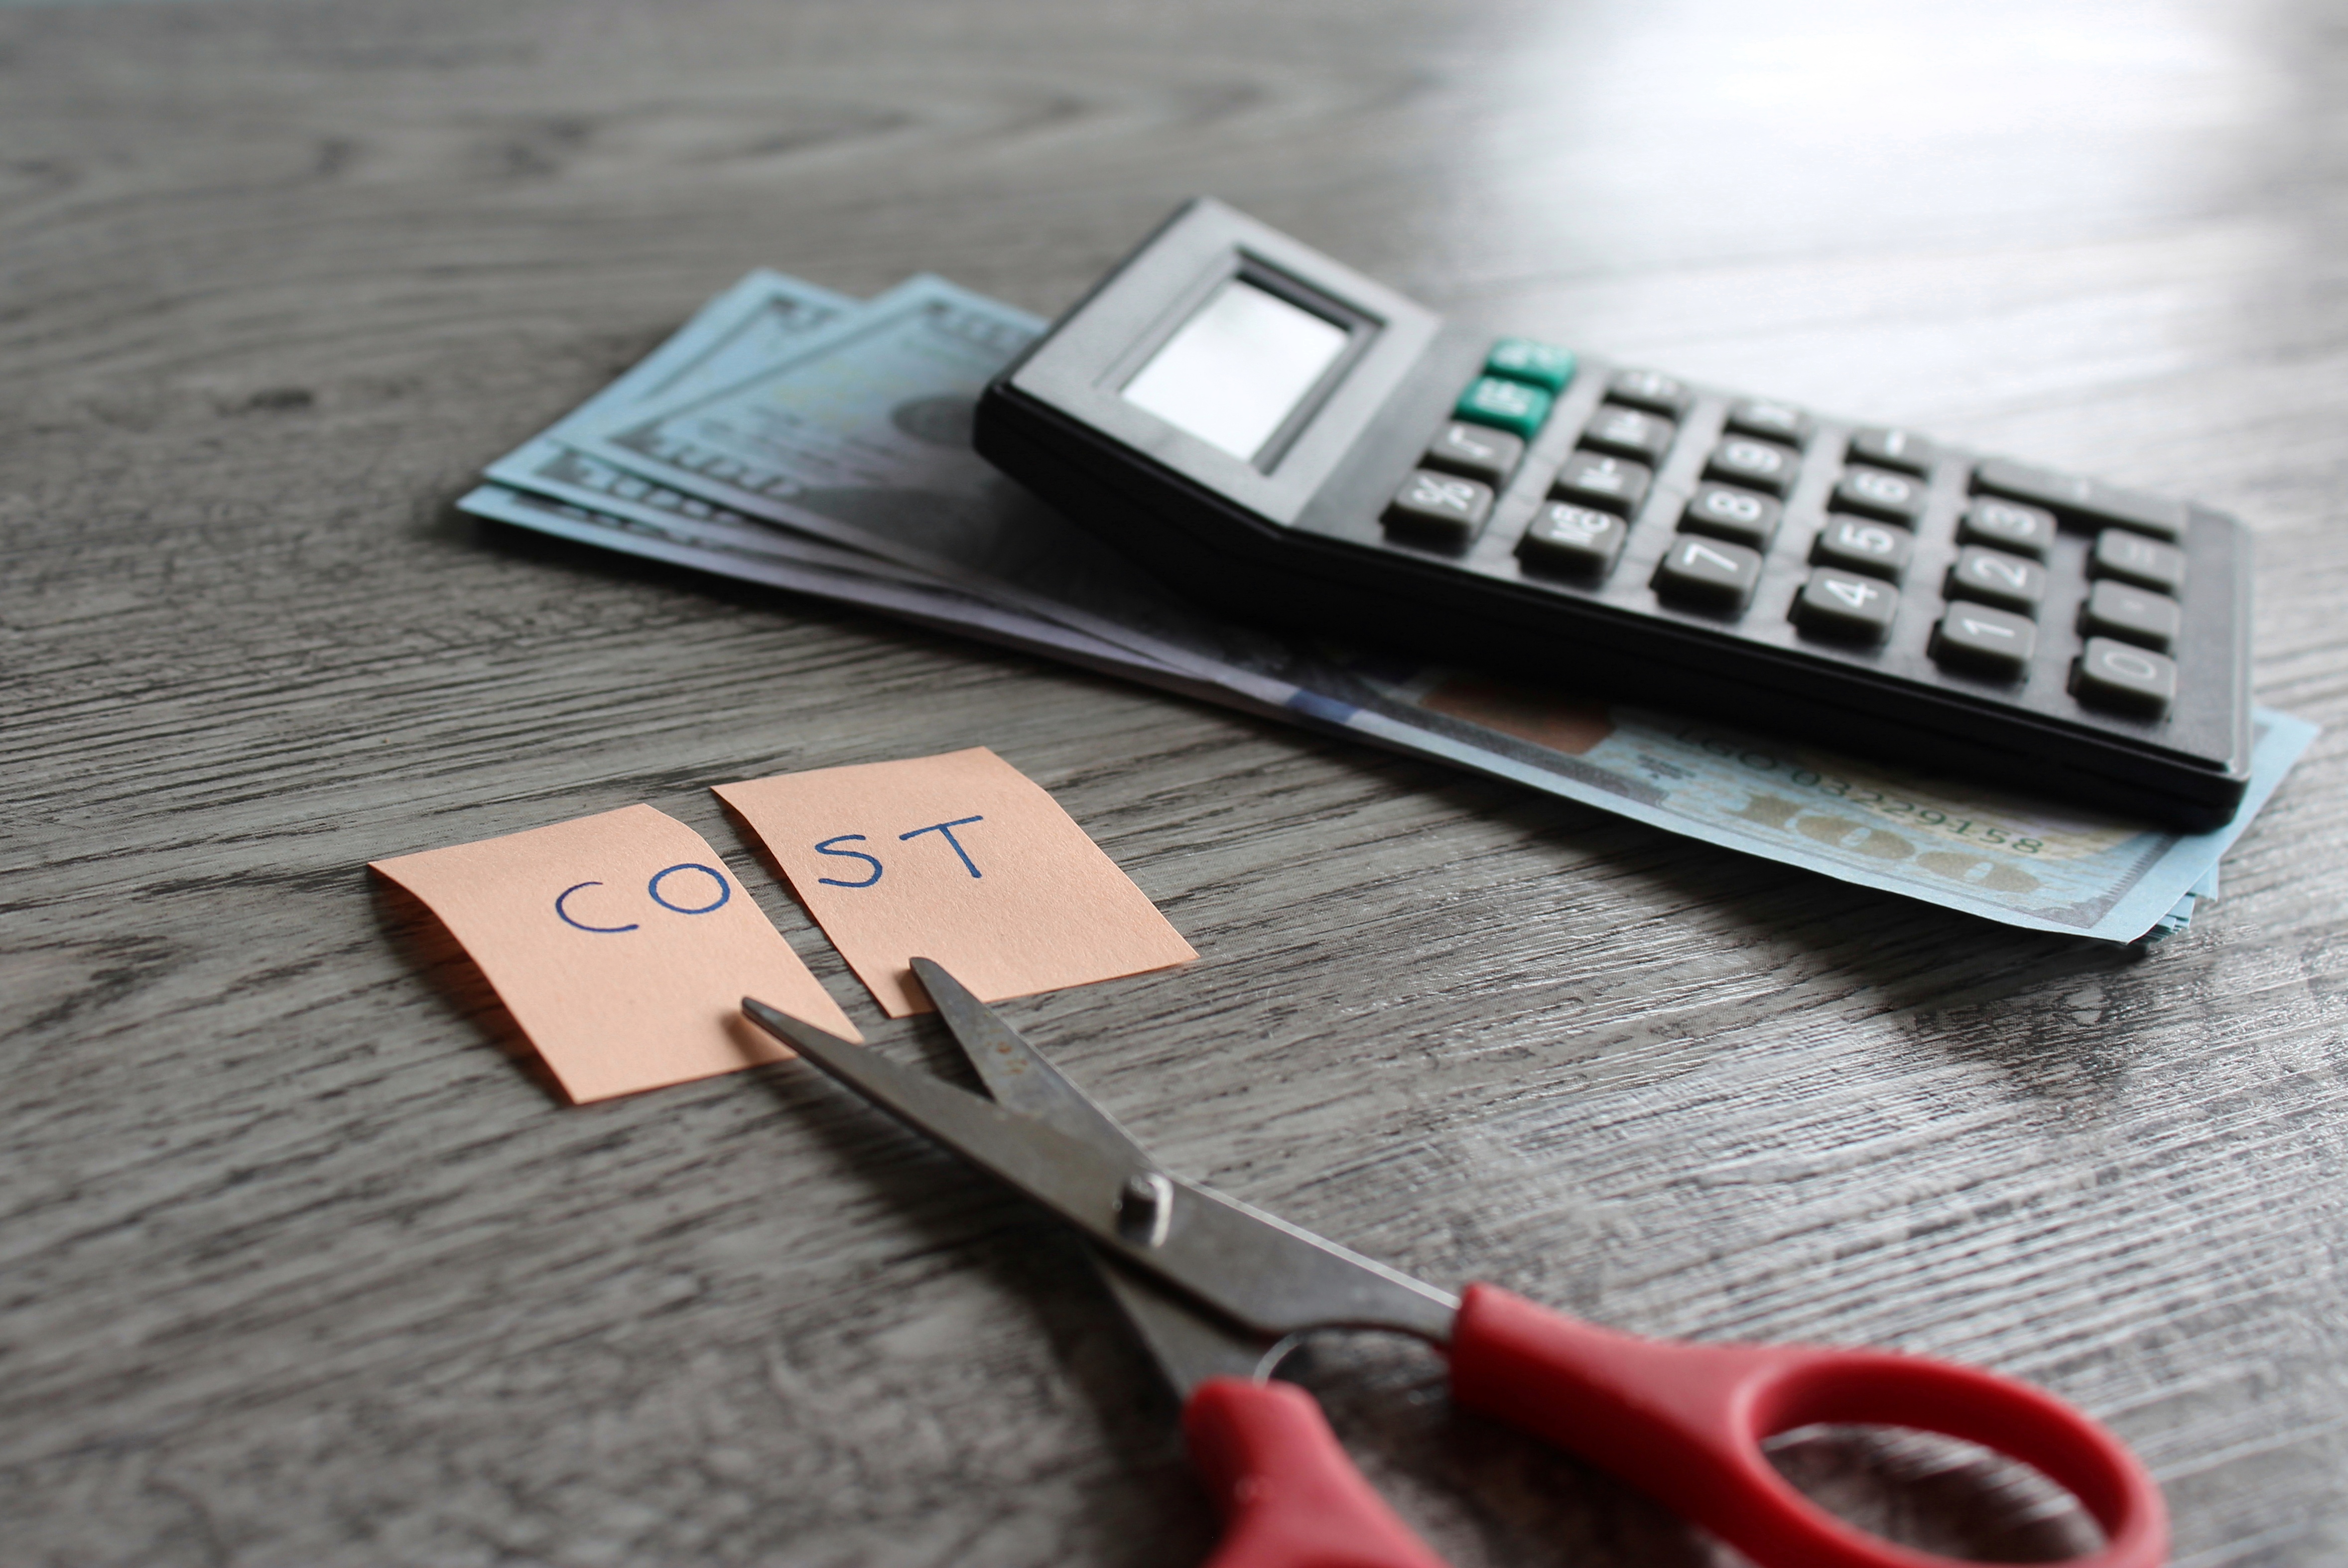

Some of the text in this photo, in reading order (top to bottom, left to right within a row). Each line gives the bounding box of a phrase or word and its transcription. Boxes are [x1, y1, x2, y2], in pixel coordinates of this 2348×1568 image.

[1725, 440, 1783, 475] 9
[1412, 476, 1474, 512] %
[1852, 470, 1911, 504] 6
[1705, 490, 1763, 522] 8
[1982, 505, 2037, 537] 3
[1838, 523, 1894, 555] 5
[1682, 542, 1739, 573] 7
[1971, 555, 2028, 589] 2
[1823, 578, 1880, 609] 4
[1960, 617, 2016, 639] 1
[2101, 650, 2157, 681] 0
[814, 815, 984, 889] ST
[1727, 795, 2041, 895] 100
[555, 862, 731, 933] CO
